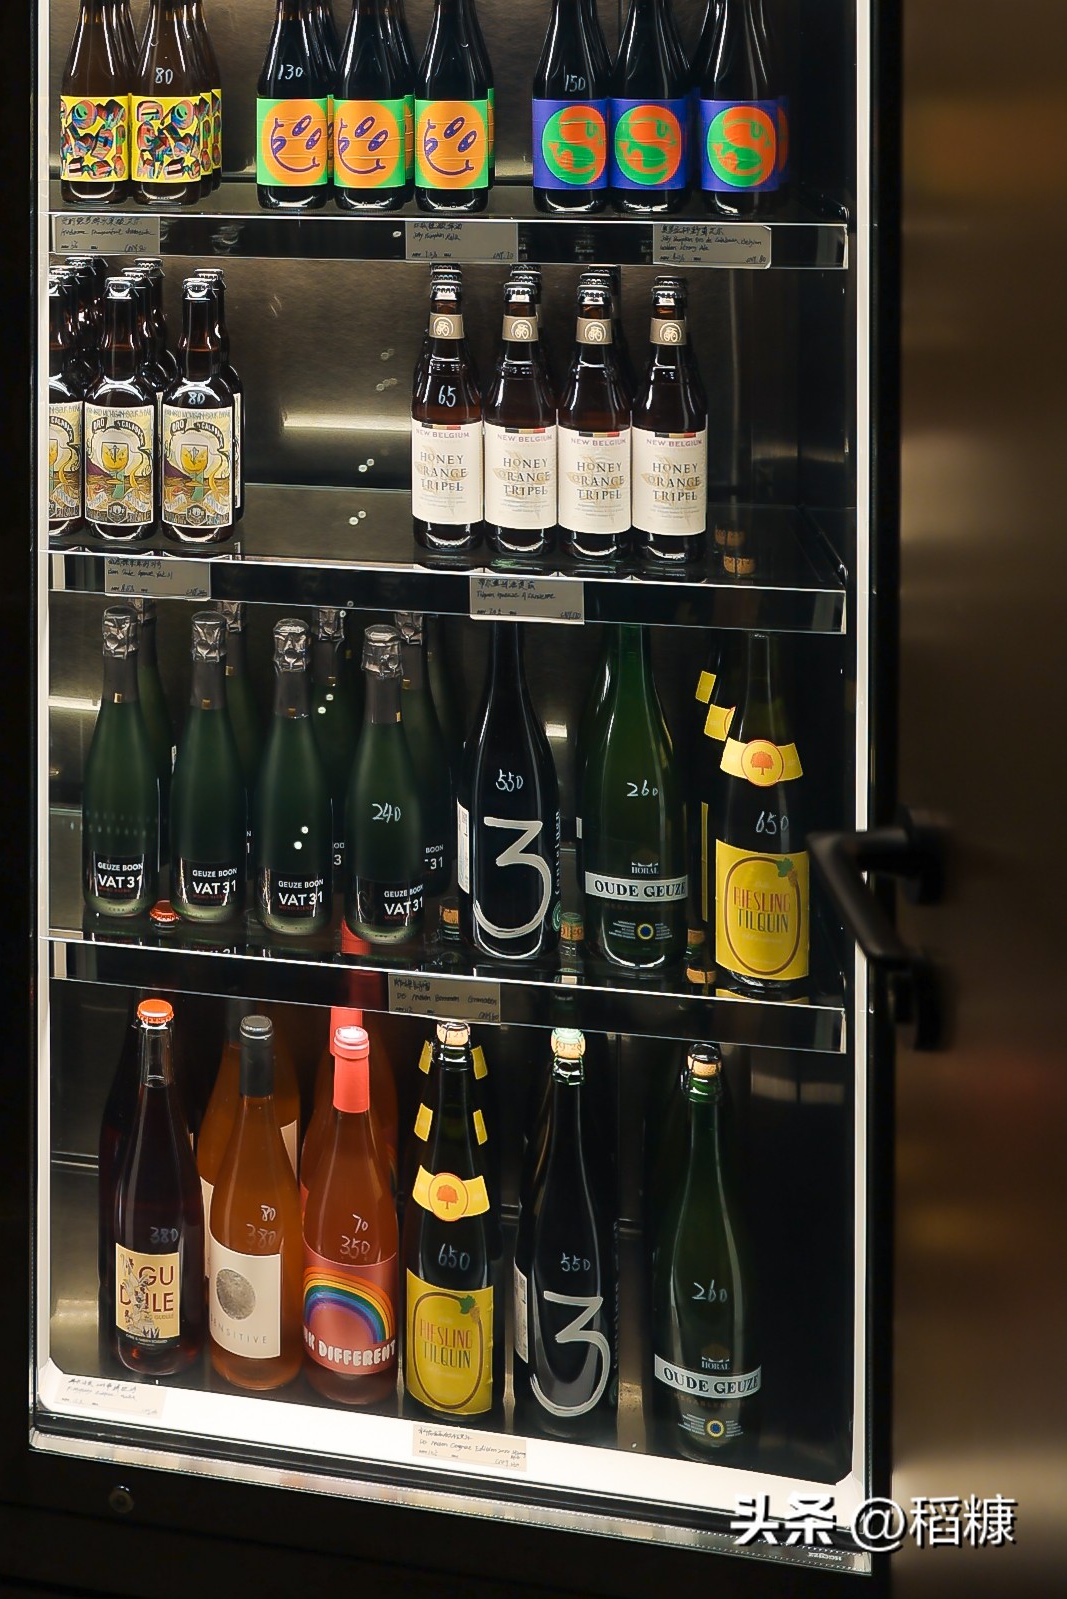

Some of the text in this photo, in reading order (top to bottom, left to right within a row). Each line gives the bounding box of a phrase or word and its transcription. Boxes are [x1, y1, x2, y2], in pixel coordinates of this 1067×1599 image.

[155, 67, 173, 84] 80
[277, 64, 303, 80] 130
[564, 74, 585, 91] 150
[188, 392, 205, 405] 80
[438, 385, 456, 407] 65
[497, 434, 552, 443] NEW BELGIUM
[646, 438, 702, 447] NEW BELGIUM
[503, 457, 548, 468] HONEY
[652, 462, 697, 473] HONEY
[498, 470, 550, 482] ORANGE
[648, 475, 701, 487] ORANGE
[503, 484, 548, 496] TRIPEL
[653, 489, 697, 501] TRIPEL
[626, 781, 659, 797] 260
[372, 802, 402, 822] 240
[756, 812, 789, 834] 650
[192, 868, 237, 878] GEUZE BOON
[475, 816, 552, 938] 3
[192, 880, 236, 895] VAT 31
[278, 879, 323, 889] GEUZE BOON
[594, 878, 686, 897] OUDE GEUZE
[278, 891, 323, 906] VAT 31
[734, 886, 791, 914] RIESLING
[737, 908, 789, 933] TILQUIN
[261, 1204, 275, 1221] 80
[353, 1214, 368, 1232] 70
[150, 1226, 177, 1243] 380
[340, 1236, 370, 1258] 350
[438, 1244, 470, 1271] 650
[560, 1253, 591, 1272] 550
[692, 1280, 727, 1302] 260
[420, 1319, 473, 1349] RIESLING
[319, 1340, 395, 1366] DIFFERENT
[423, 1342, 471, 1369] TILQUIN
[531, 1291, 610, 1417] 3
[663, 1367, 759, 1394] OUDE GEUZE
